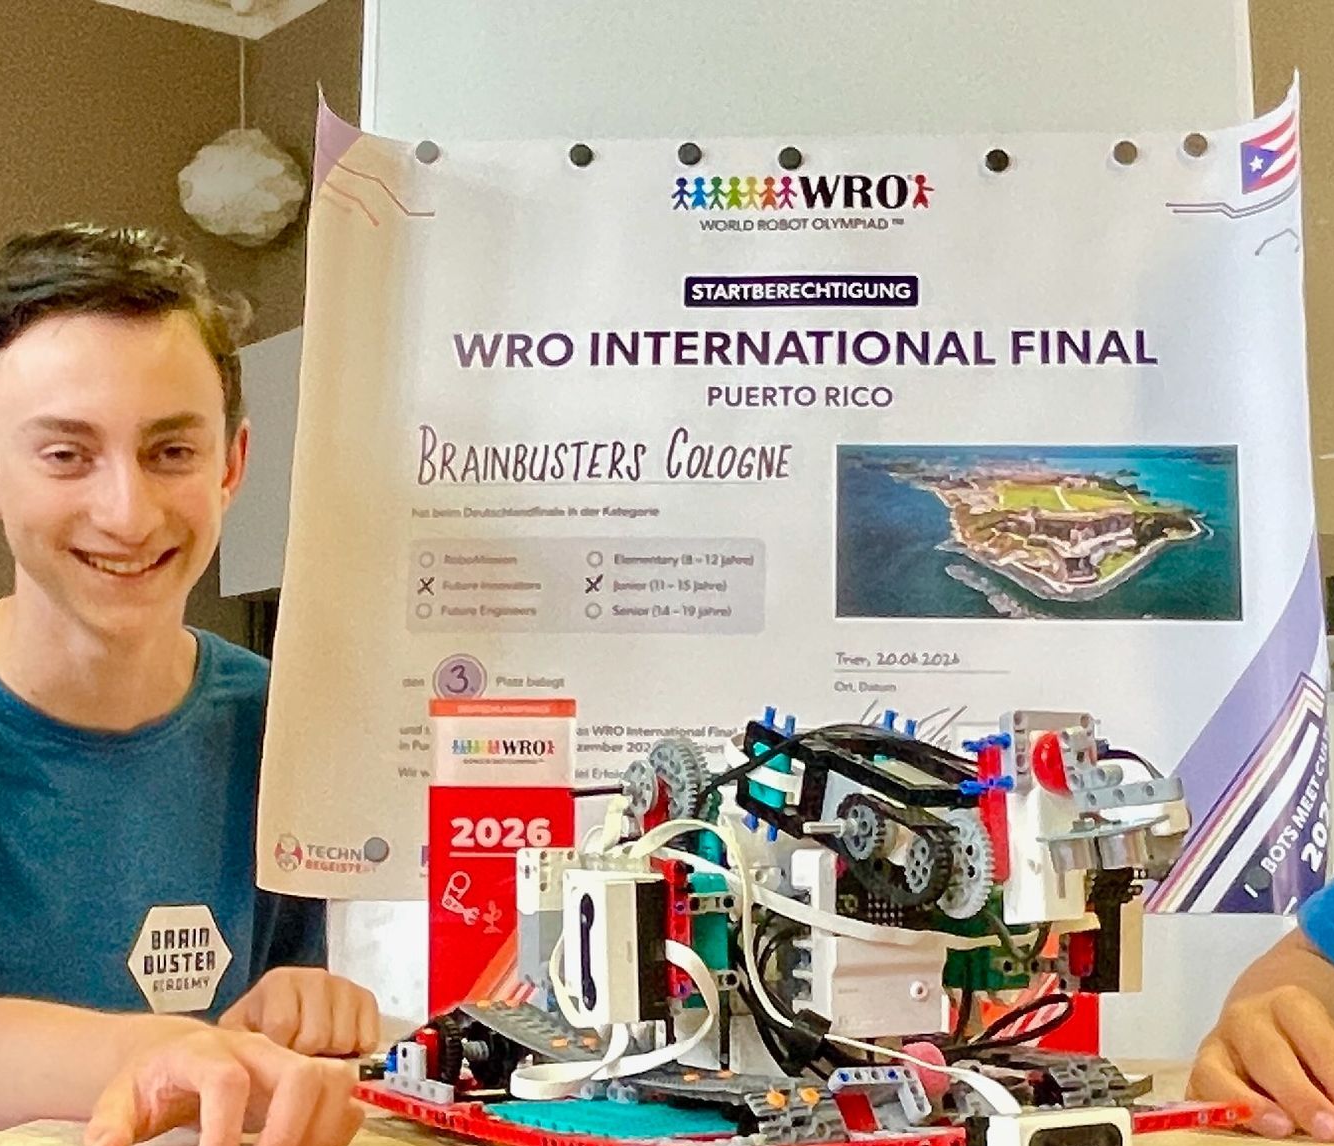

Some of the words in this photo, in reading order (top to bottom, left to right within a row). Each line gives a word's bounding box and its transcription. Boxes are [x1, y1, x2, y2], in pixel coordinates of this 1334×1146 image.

[799, 174, 908, 209] WRO
[699, 220, 754, 231] WORLD
[758, 218, 807, 230] ROBOT
[812, 218, 889, 230] OLYMPIAD
[691, 282, 911, 300] STARTBERECHTIGUNG
[454, 332, 575, 368] WRO
[589, 331, 995, 367] INTERNATIONAL
[1010, 330, 1157, 365] FINAL
[707, 386, 816, 407] PUERTO
[825, 386, 894, 407] RICO
[705, 554, 718, 566] 12
[592, 725, 625, 737] WRO
[502, 740, 546, 756] WRO
[576, 741, 623, 753] zember
[626, 741, 652, 753] 202
[1291, 775, 1320, 830] MEET
[450, 817, 552, 848] 2026
[307, 845, 367, 861] TECHN
[151, 927, 210, 950] BRAIN
[143, 950, 216, 975] BUSTER
